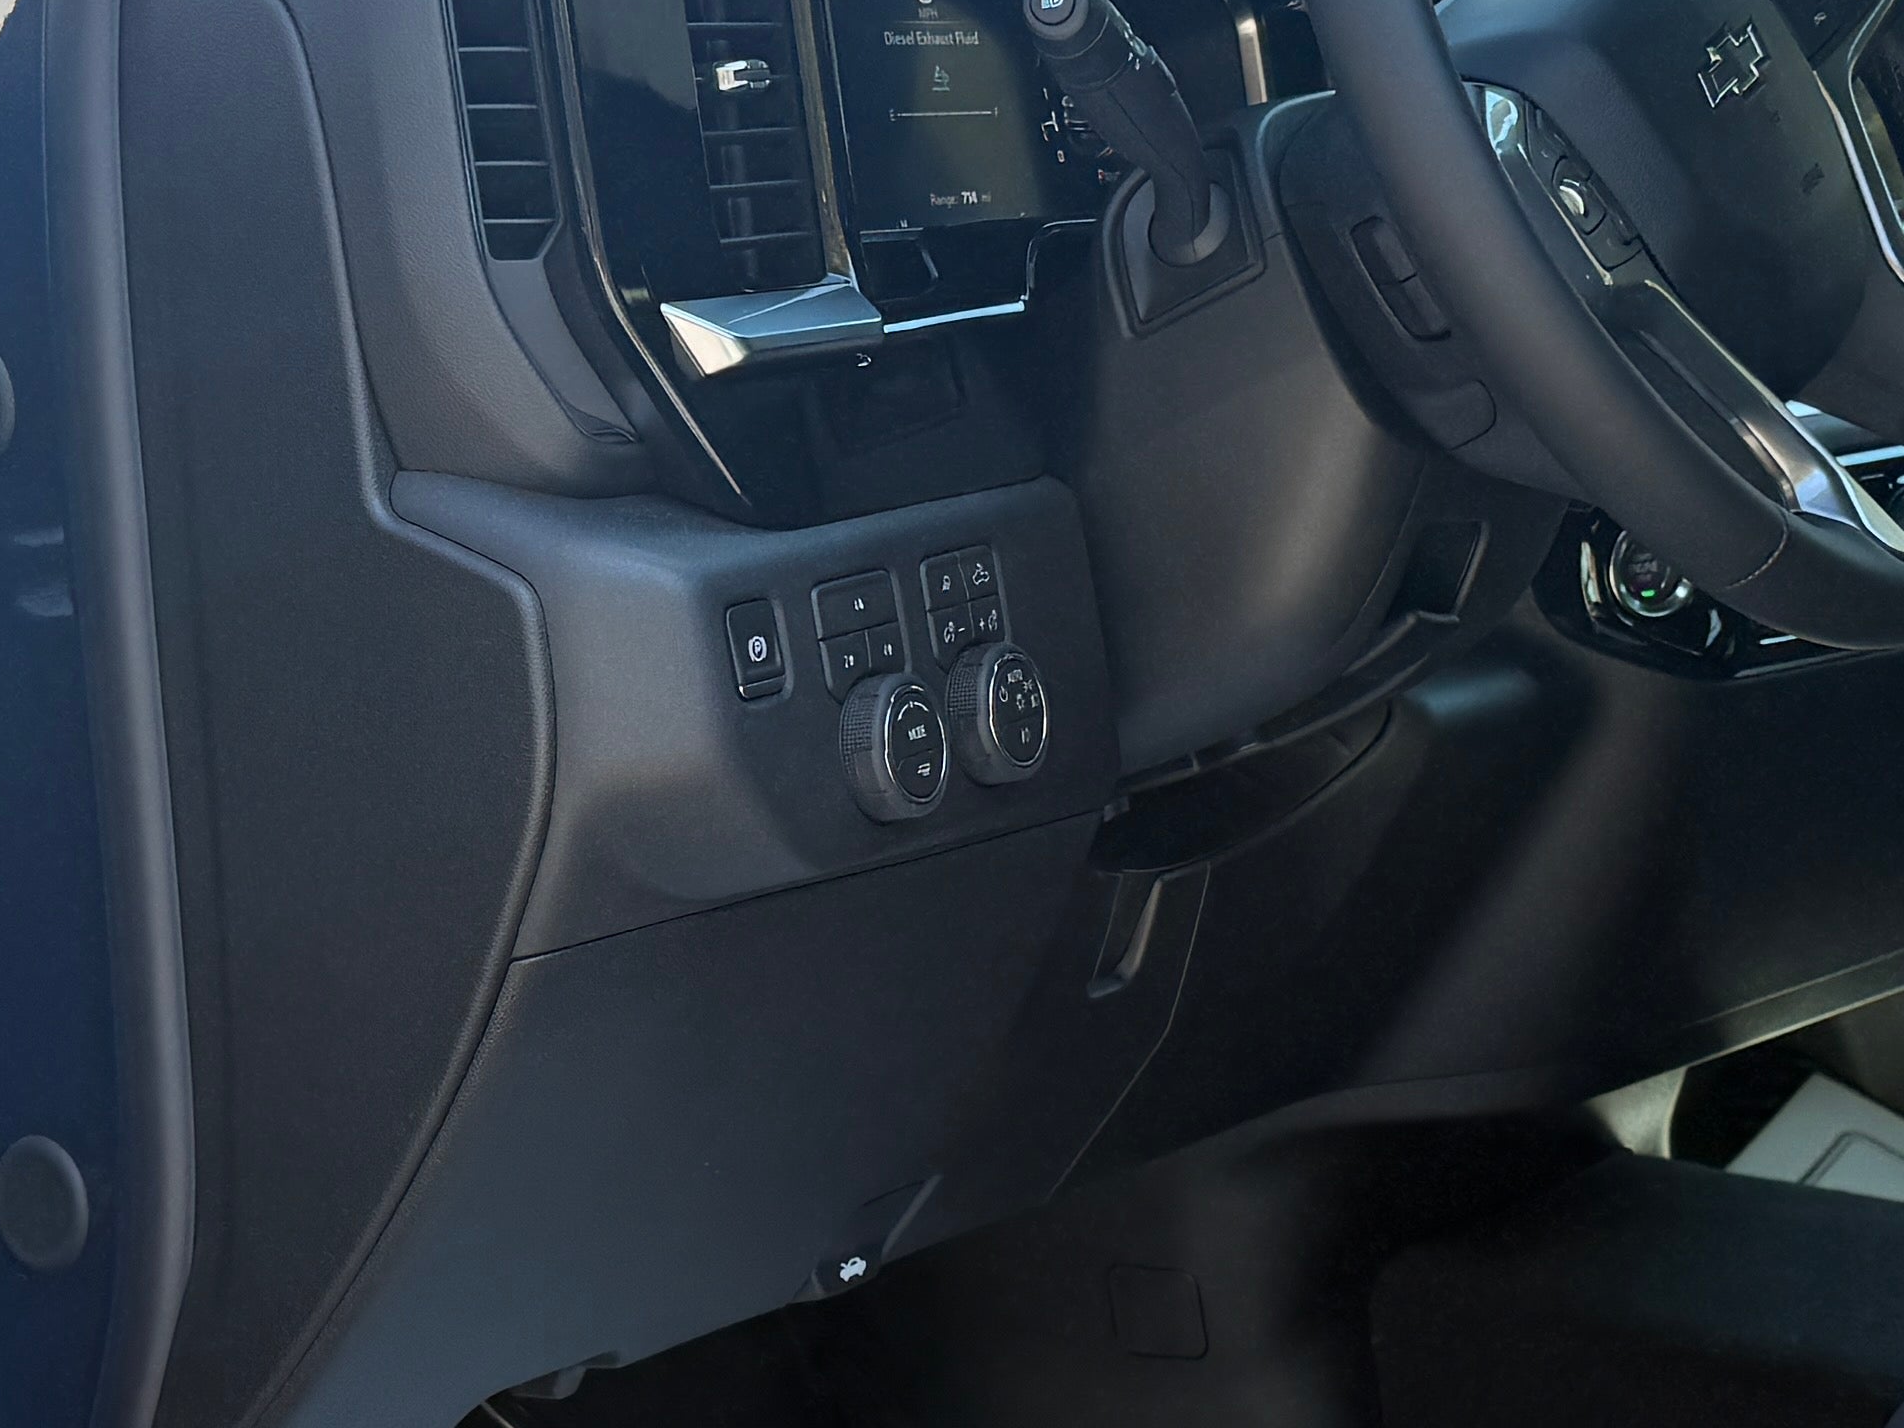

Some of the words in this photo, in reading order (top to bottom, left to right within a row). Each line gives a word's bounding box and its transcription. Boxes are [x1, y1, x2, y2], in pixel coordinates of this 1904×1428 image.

[883, 30, 914, 46] Diesel
[916, 30, 954, 46] Exhaust
[955, 30, 980, 46] Fluid
